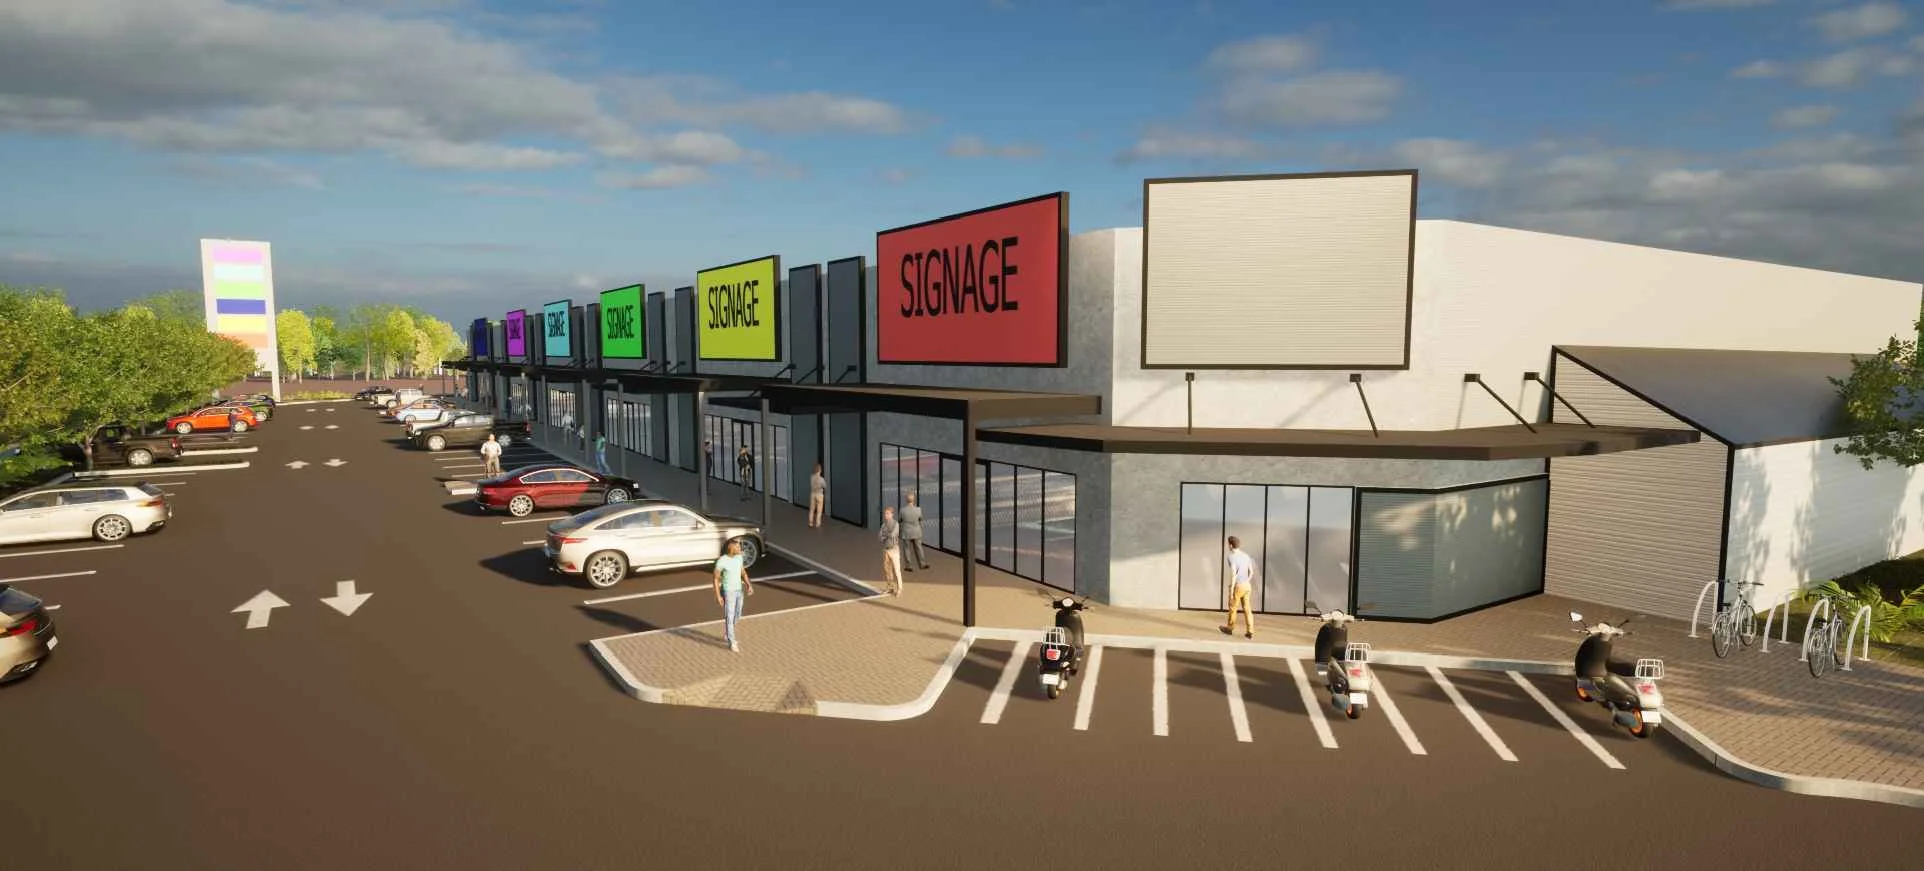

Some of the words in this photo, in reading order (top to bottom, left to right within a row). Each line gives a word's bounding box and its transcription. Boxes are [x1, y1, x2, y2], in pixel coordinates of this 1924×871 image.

[900, 237, 1018, 318] SIGNAGE
[607, 305, 634, 339] SIGNAGE
[708, 280, 759, 329] SIGNAGE
